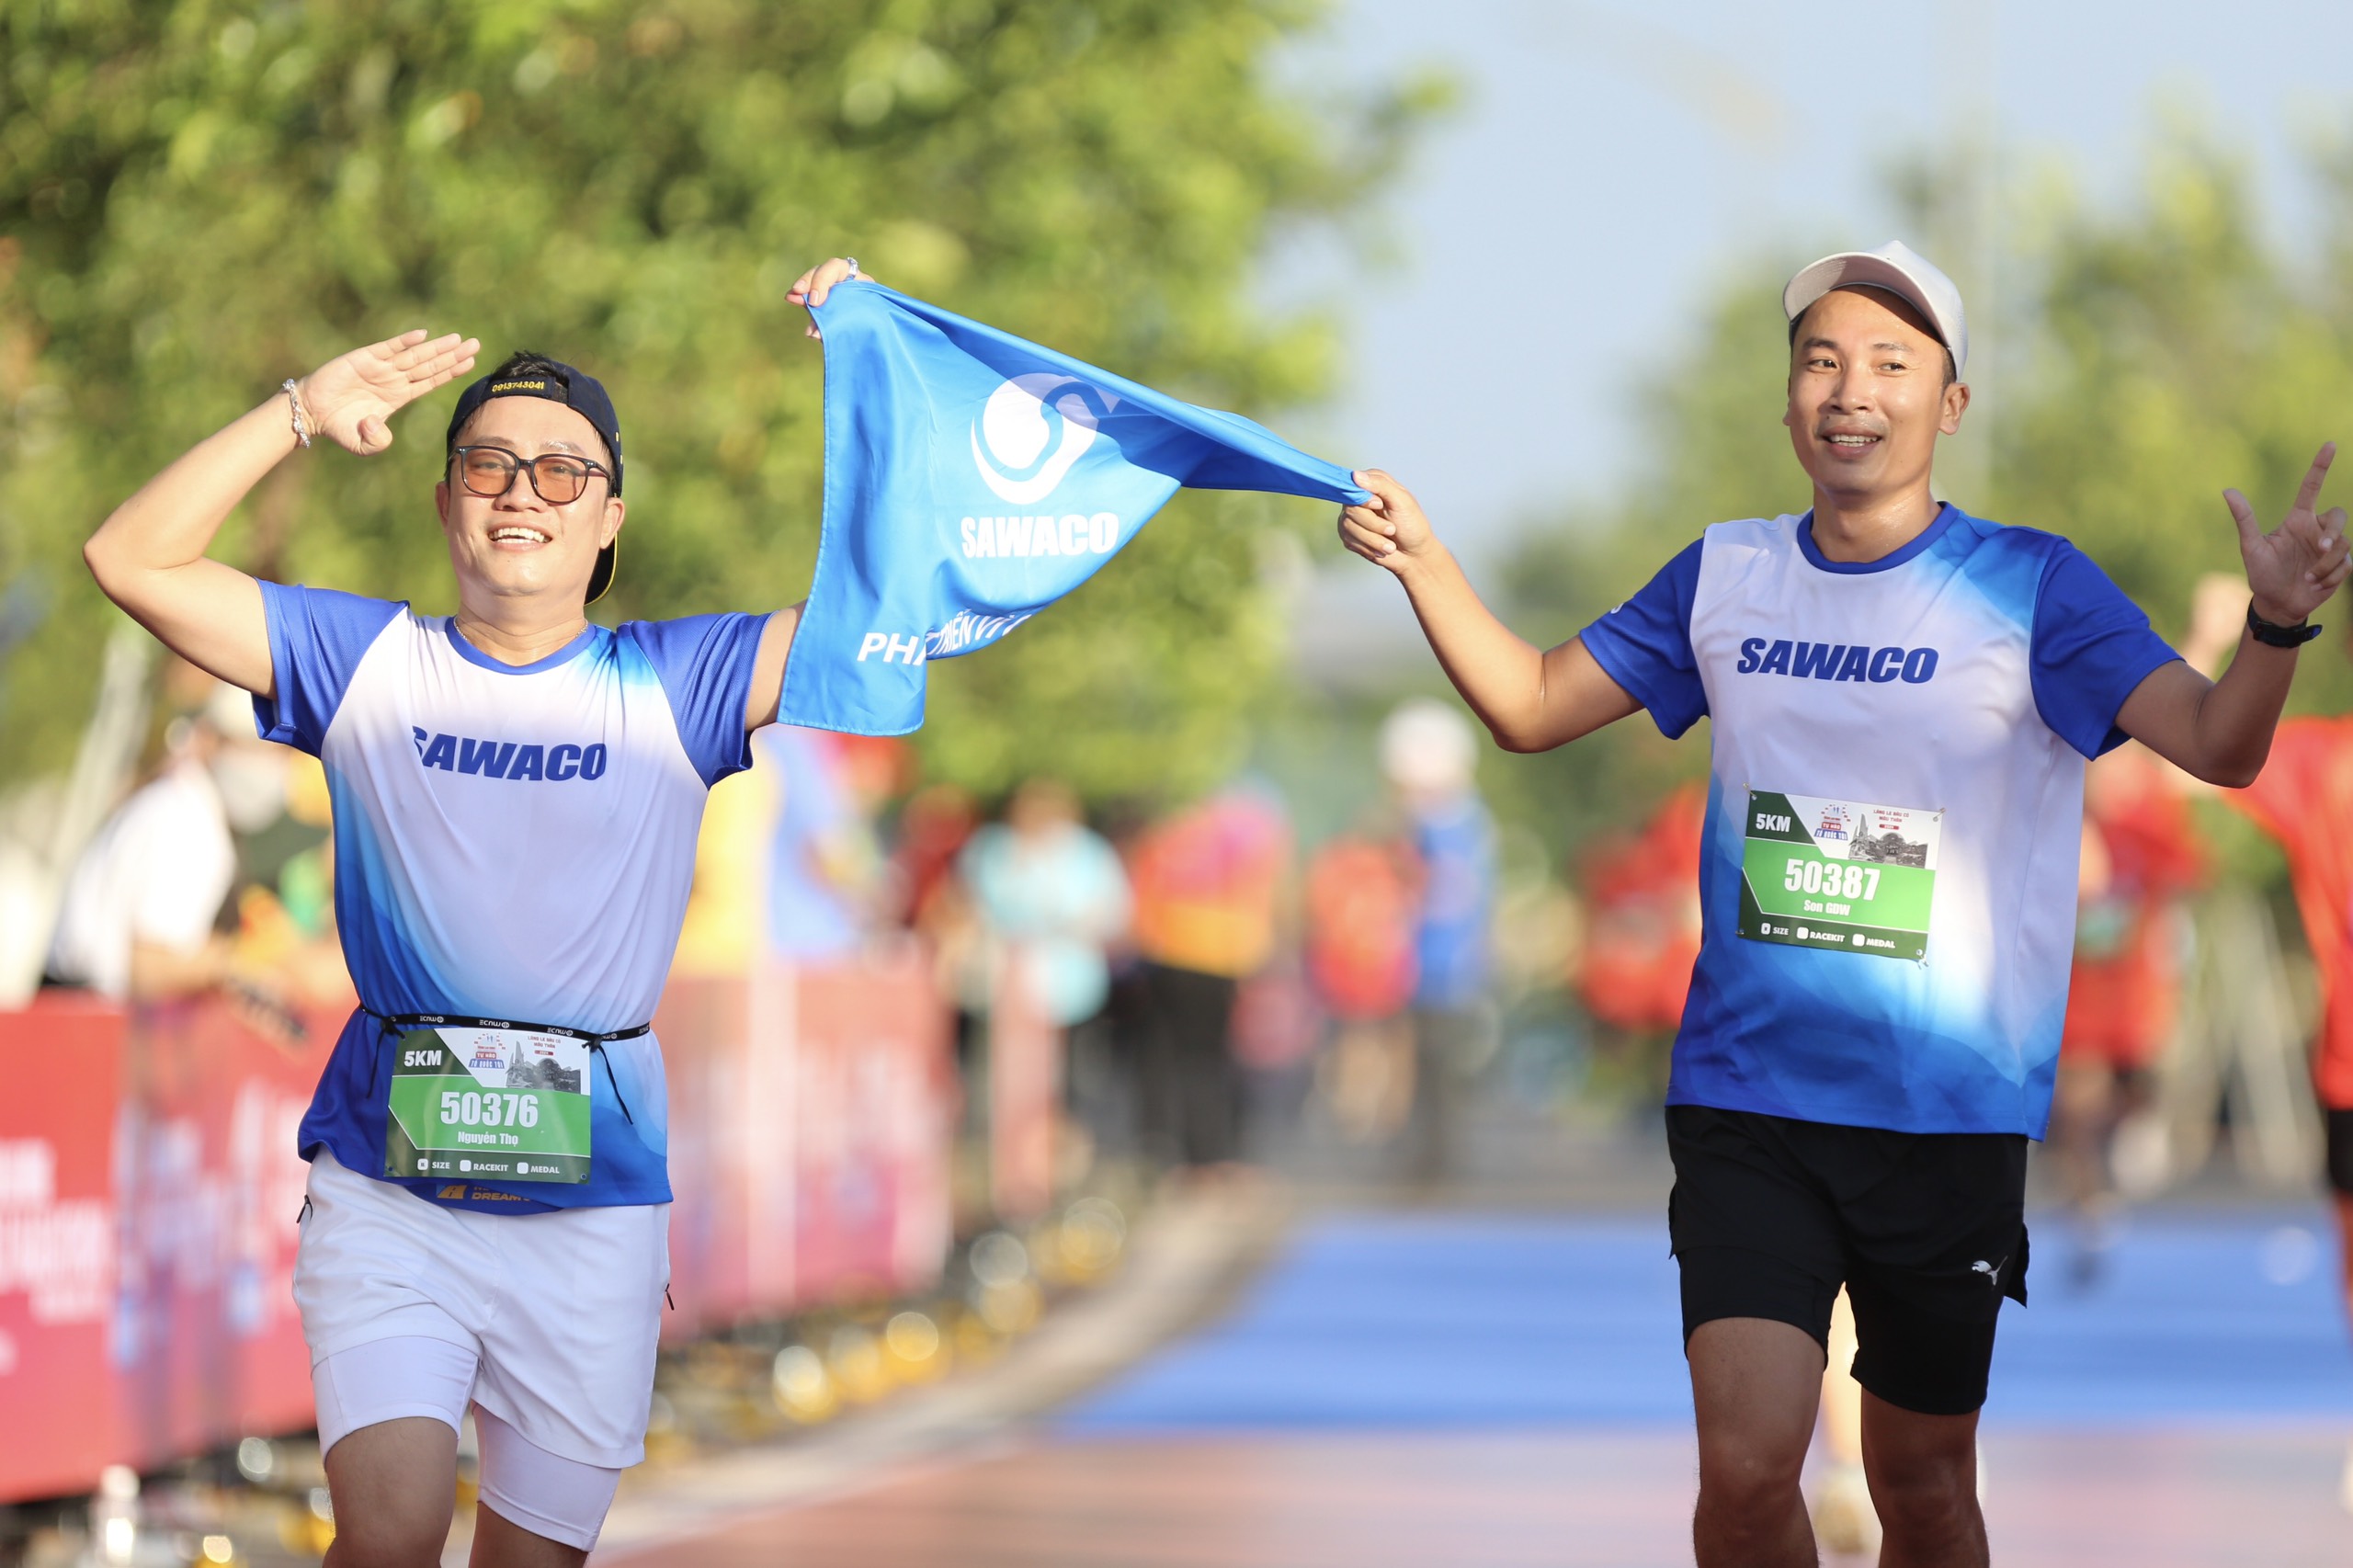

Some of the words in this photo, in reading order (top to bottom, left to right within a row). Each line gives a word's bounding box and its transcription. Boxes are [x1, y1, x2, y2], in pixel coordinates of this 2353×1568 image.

[960, 511, 1120, 559] SAWACO
[1736, 637, 1939, 684] SAWACO
[1756, 812, 1791, 833] 5KM
[1784, 858, 1881, 901] 50387
[1803, 899, 1824, 913] Son
[1772, 927, 1790, 936] SIZE
[1810, 931, 1846, 943] RACEKIT
[1867, 938, 1895, 948] MEDAL
[404, 1050, 442, 1067] 5KM
[440, 1091, 539, 1129] 50376
[499, 1131, 519, 1148] Thọ
[431, 1161, 450, 1170] SIZE
[472, 1163, 509, 1173] RACEKIT
[530, 1165, 561, 1175] MEDAL
